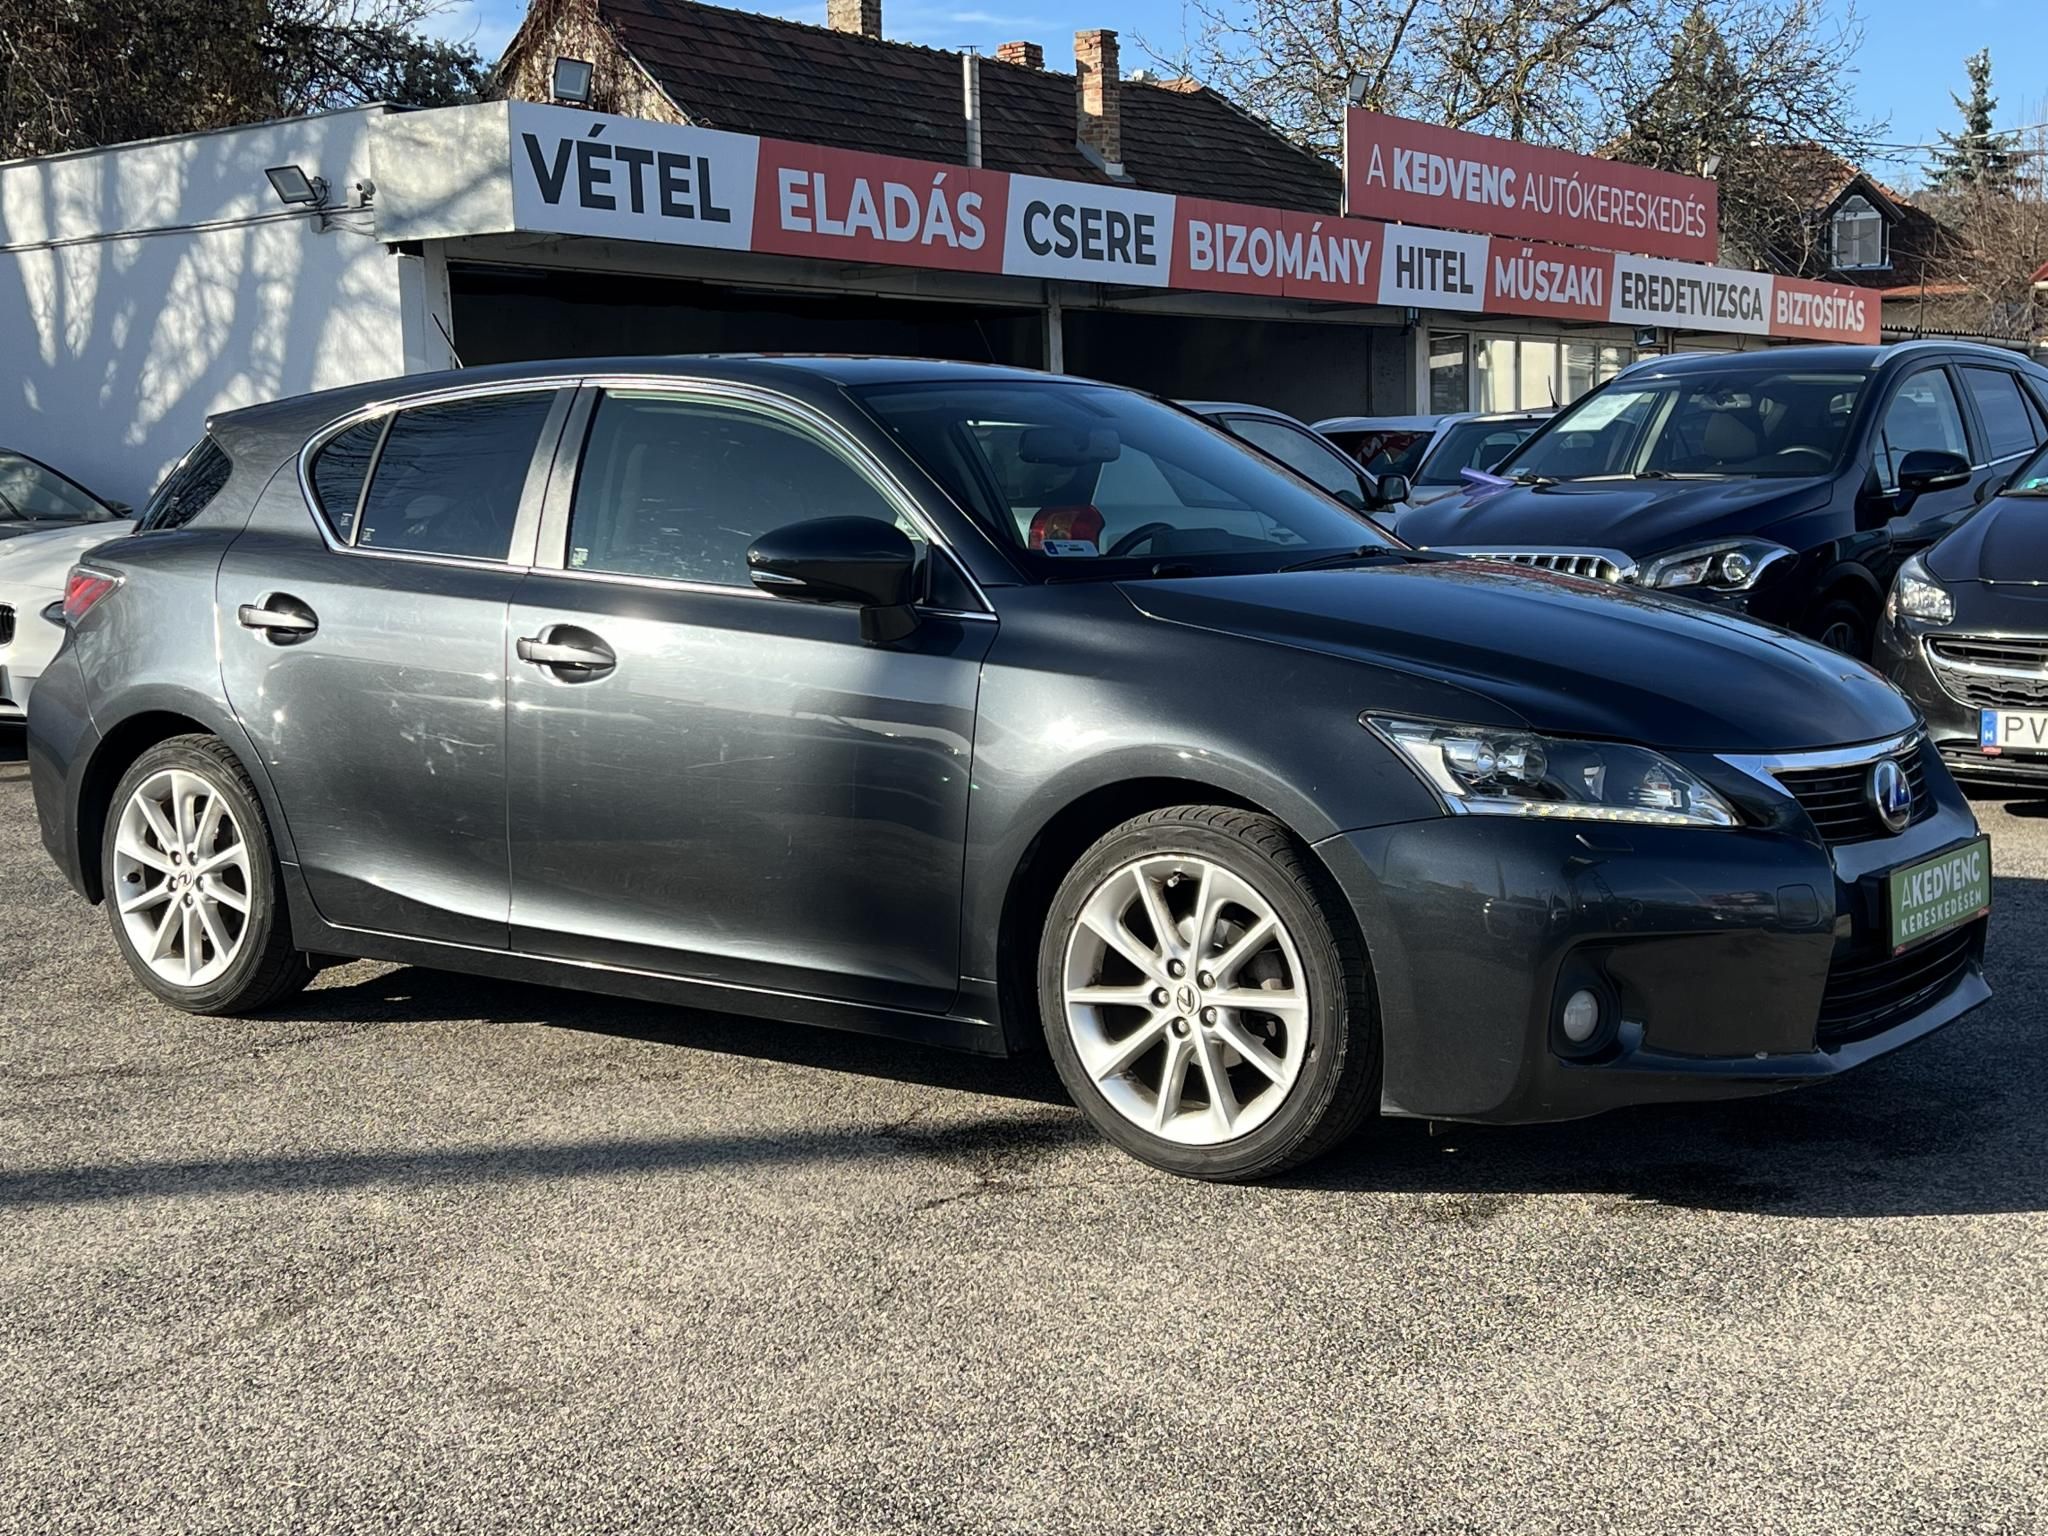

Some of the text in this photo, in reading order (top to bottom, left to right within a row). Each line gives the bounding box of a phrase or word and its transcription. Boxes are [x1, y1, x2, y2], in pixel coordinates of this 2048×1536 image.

[521, 123, 1865, 333] VÉTEL ELADÁS CSERE BIZOMÁNY HITEL MŰSZAKI EREDETVIZSGA BIZTOSÍTÁS
[1366, 143, 1707, 239] A KEDVENC AUTÓKERESKEDÉS
[2004, 715, 2048, 744] PV
